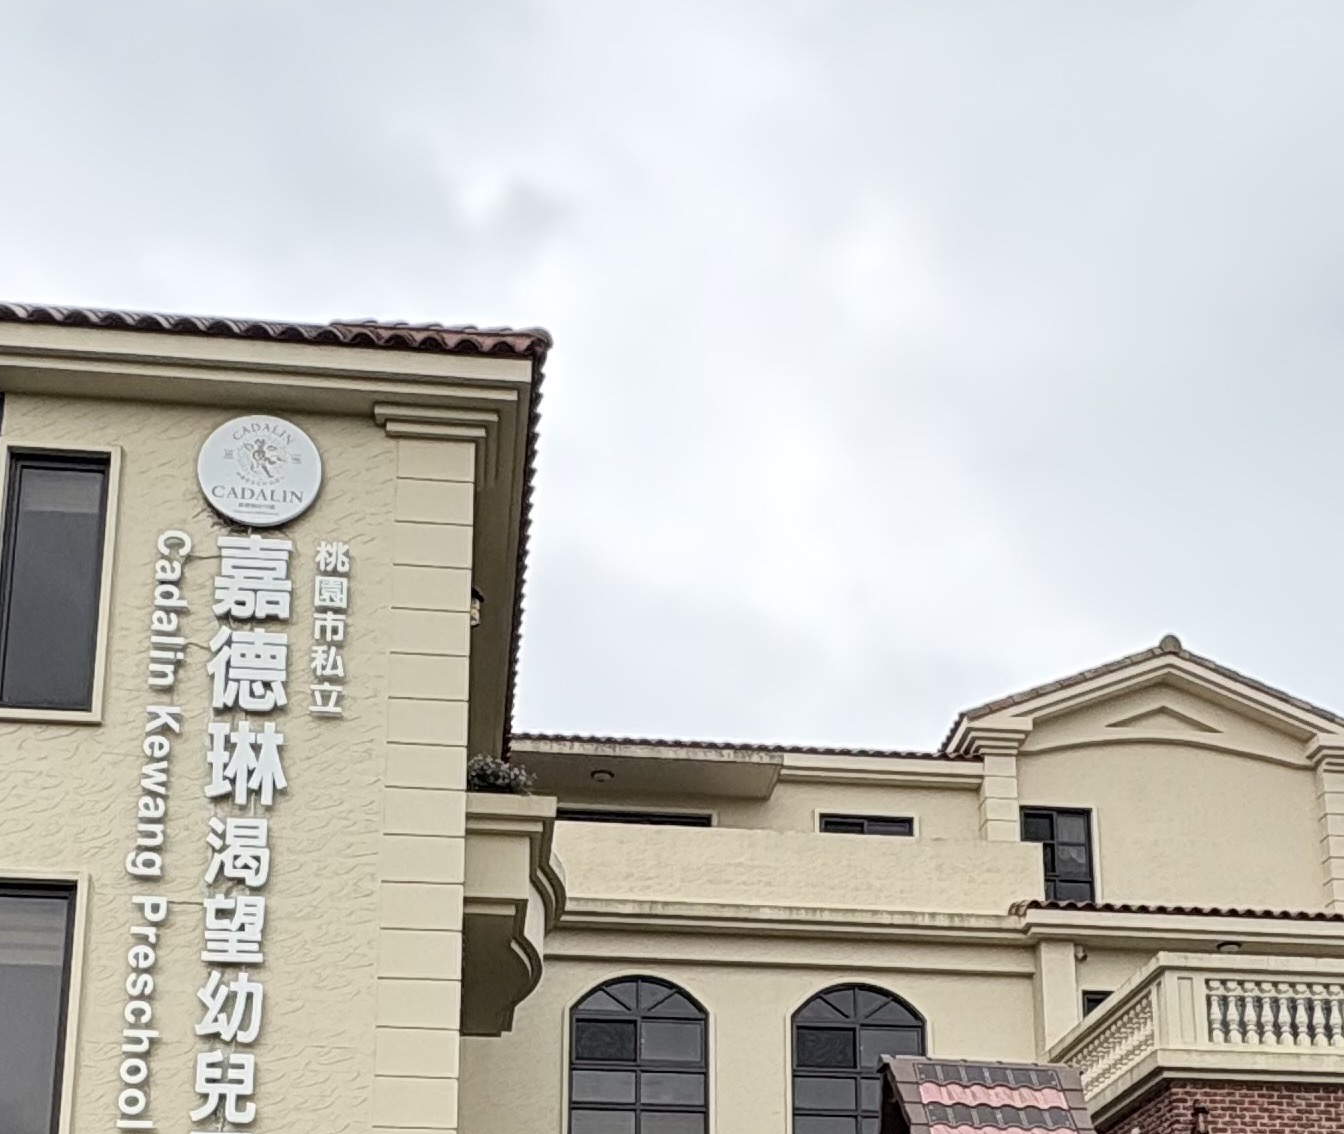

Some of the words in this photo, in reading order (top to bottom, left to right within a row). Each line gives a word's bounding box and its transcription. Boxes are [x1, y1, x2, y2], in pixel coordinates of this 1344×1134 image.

[211, 485, 304, 504] CADALIN
[147, 530, 192, 690] Cadalin
[308, 541, 351, 718] 桃園市私立
[125, 705, 182, 876] Kewang
[116, 896, 168, 1129] Preschool
